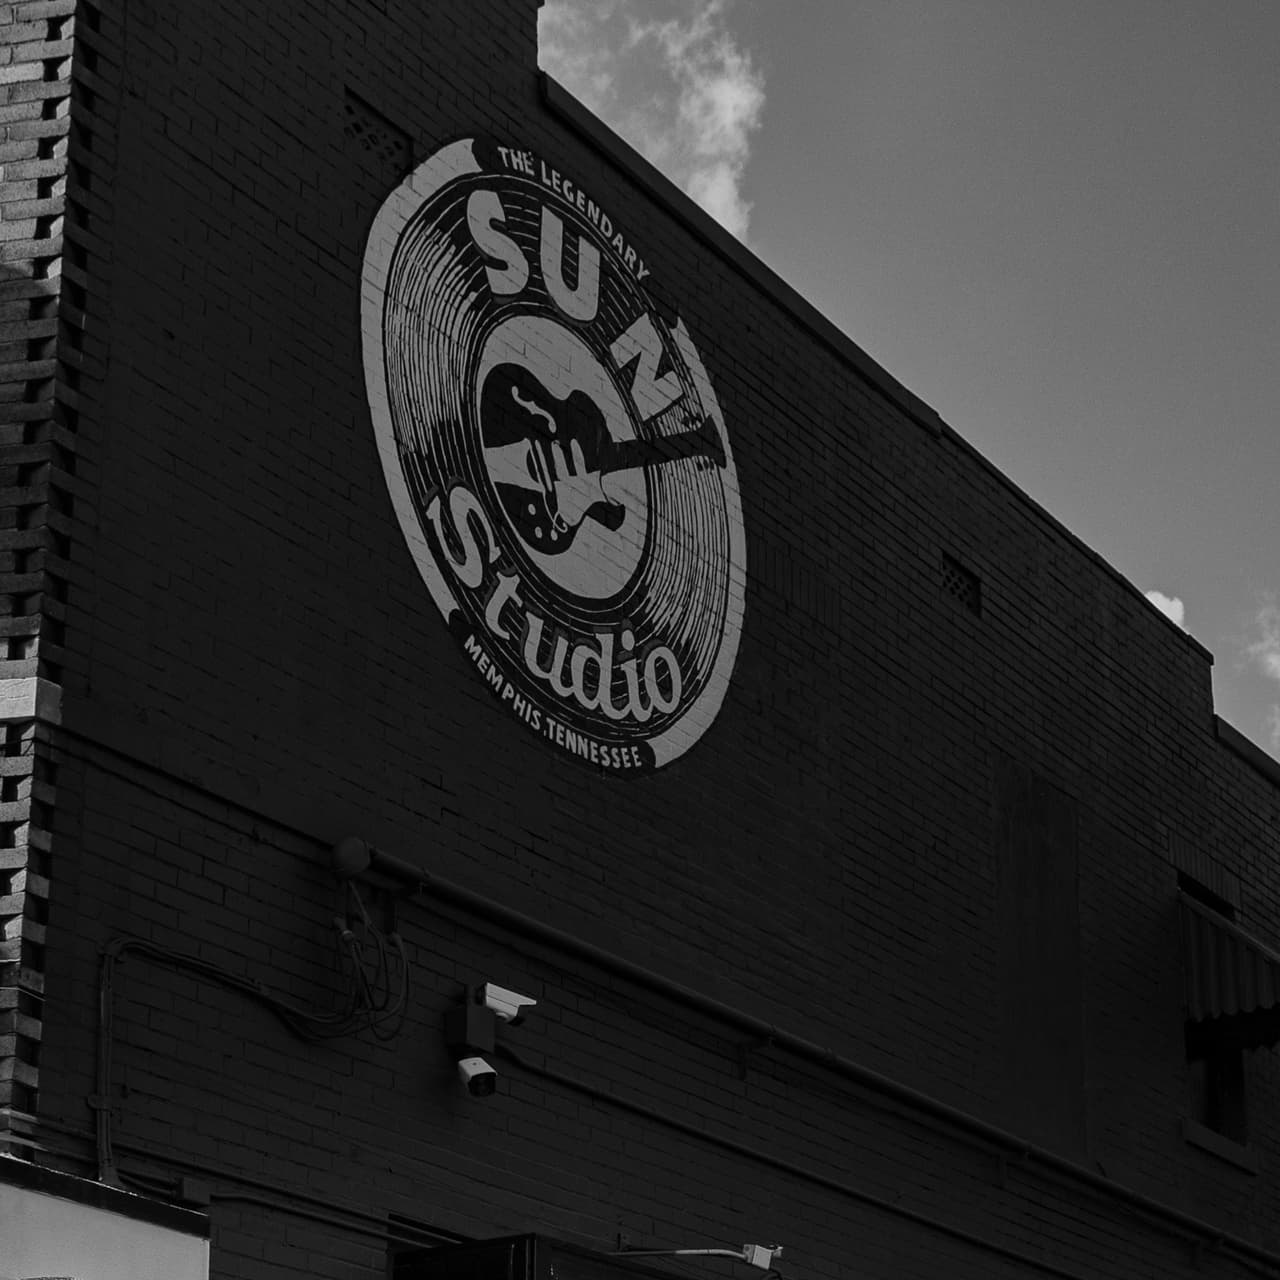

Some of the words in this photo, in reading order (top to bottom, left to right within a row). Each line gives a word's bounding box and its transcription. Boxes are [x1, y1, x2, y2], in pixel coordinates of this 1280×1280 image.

[467, 189, 683, 421] SUN
[497, 146, 535, 176] THE
[540, 160, 651, 281] LEGENDARY
[426, 486, 682, 722] Studio
[546, 717, 643, 769] TENNESSEE
